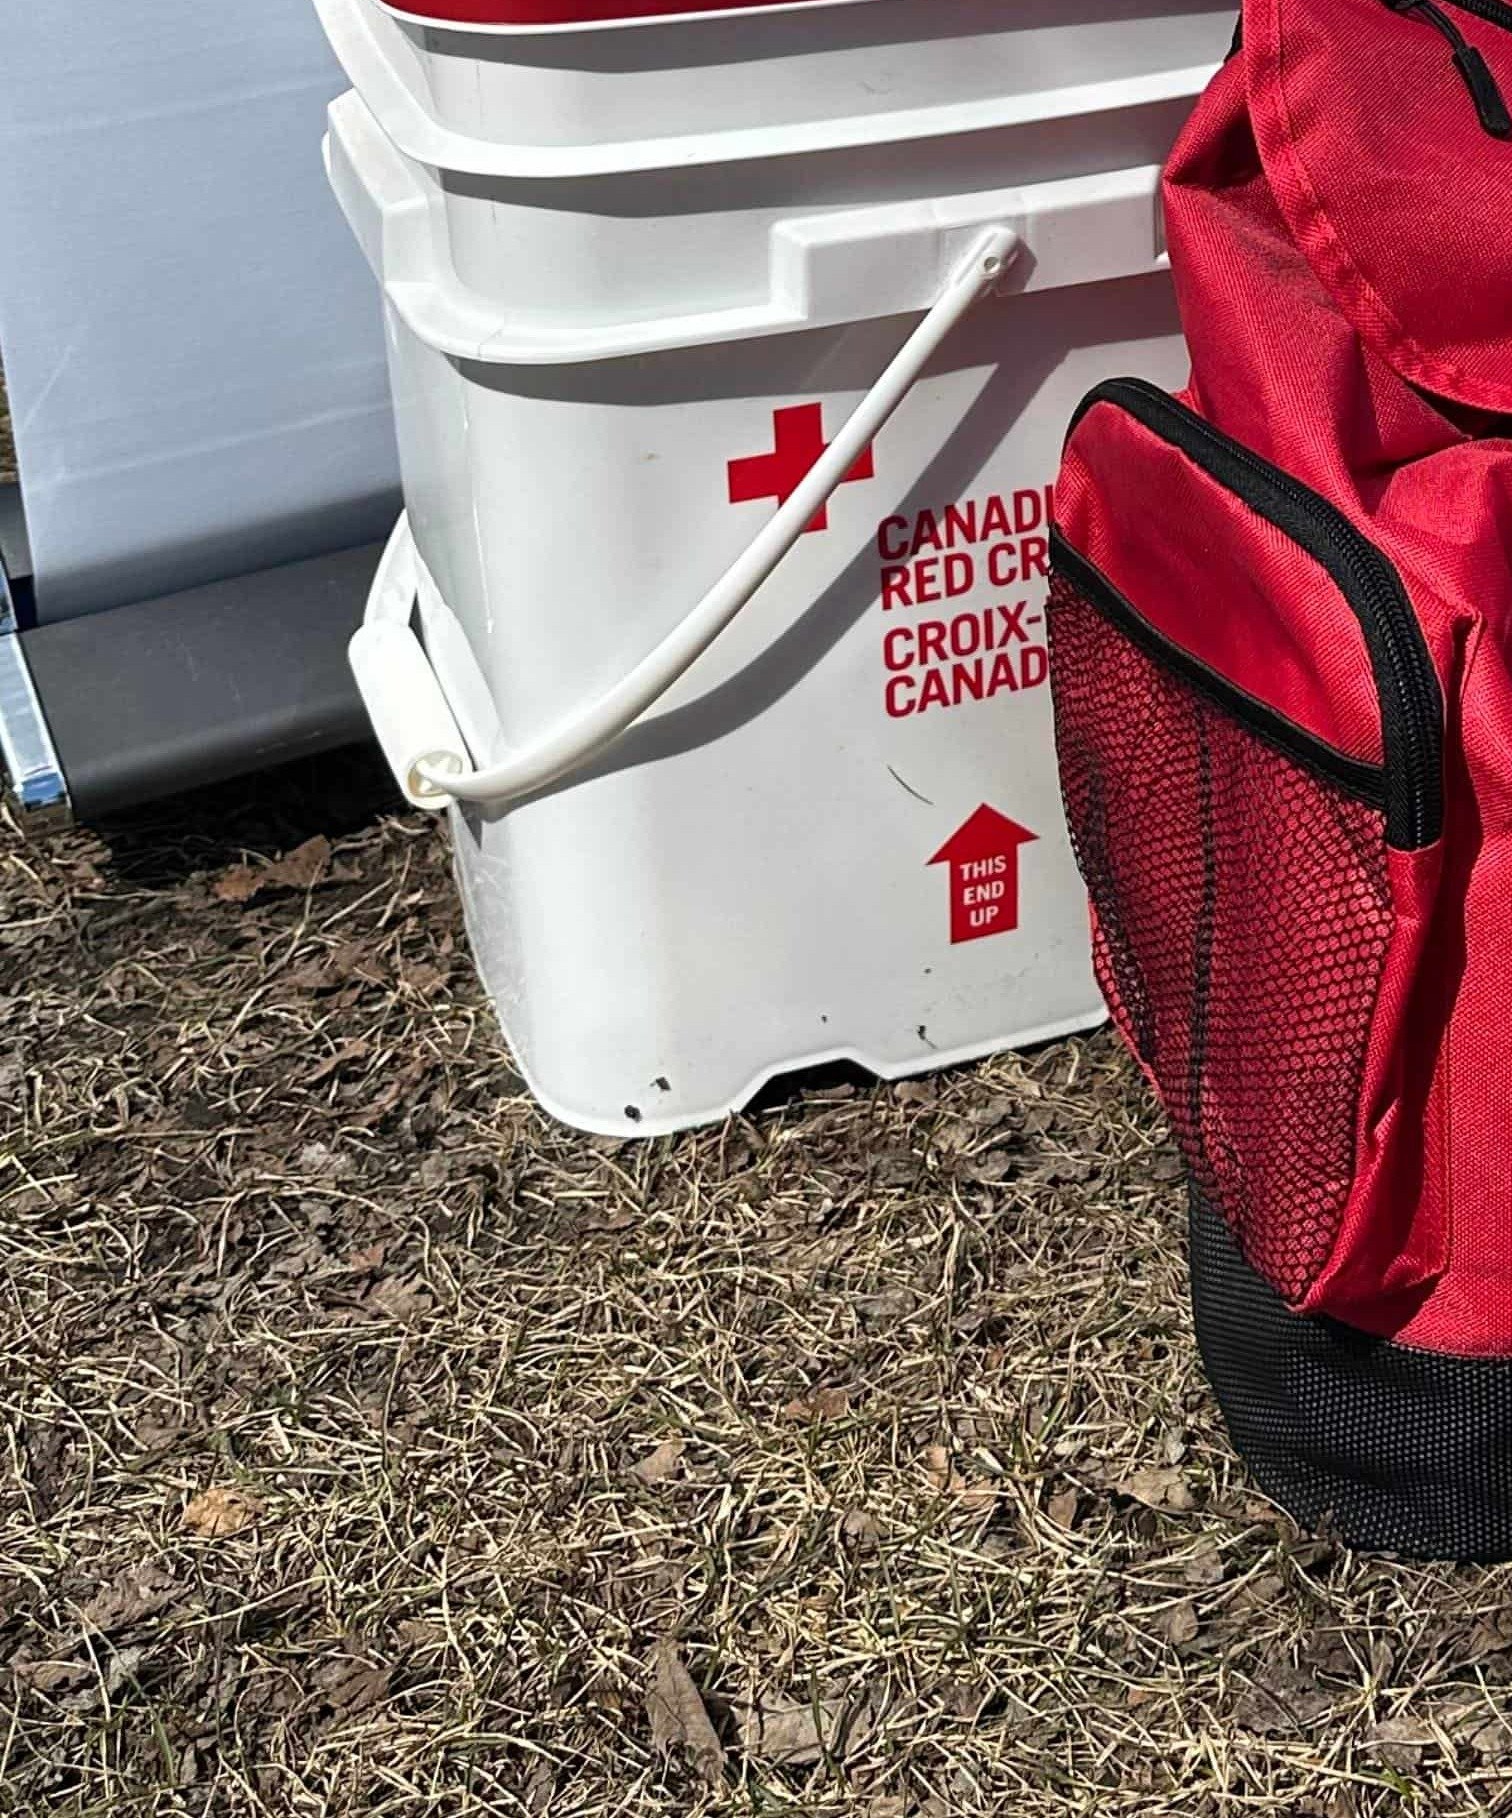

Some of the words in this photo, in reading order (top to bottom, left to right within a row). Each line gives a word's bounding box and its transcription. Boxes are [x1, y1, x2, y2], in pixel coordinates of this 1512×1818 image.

[876, 484, 1056, 561] CANADI
[881, 551, 976, 611] RED
[882, 600, 1044, 673] CROIX-
[884, 645, 1049, 719] CANAD
[960, 854, 1007, 880] THIS
[963, 879, 1006, 906] END
[969, 904, 1000, 928] UP
